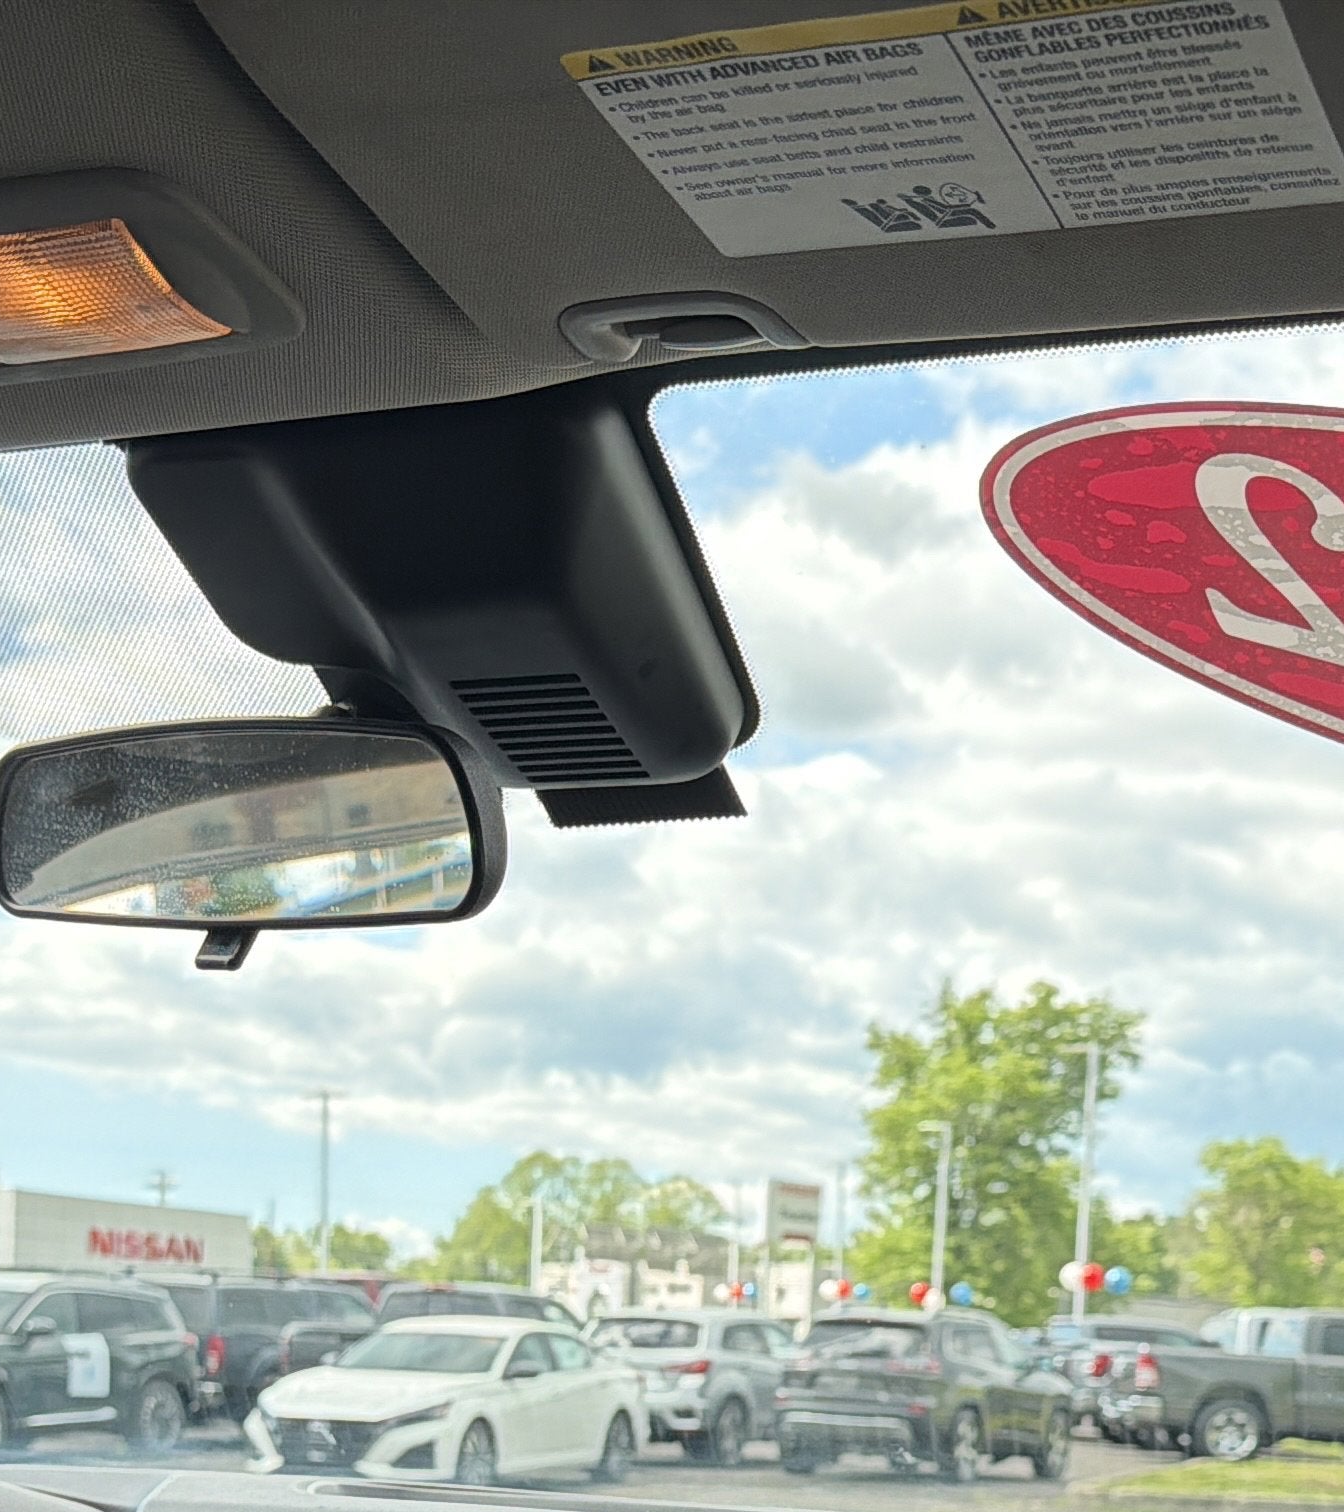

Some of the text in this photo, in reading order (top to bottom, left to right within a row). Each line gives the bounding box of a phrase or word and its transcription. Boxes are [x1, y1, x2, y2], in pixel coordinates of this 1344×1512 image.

[1031, 20, 1082, 39] AVEC
[1085, 14, 1127, 32] DES
[1131, 2, 1234, 26] COUSSINS
[616, 37, 737, 66] WARNING
[974, 35, 1100, 62] GONFLABLES
[1020, 60, 1078, 74] enfants
[1080, 51, 1143, 68] peuvent
[594, 42, 922, 96] EVEN WITH ADVANCED AIR BAGS
[618, 65, 918, 112] Children can be killed or seriously injured
[1130, 90, 1164, 104] pour
[1196, 81, 1254, 95] enfants
[640, 130, 670, 140] The
[670, 125, 706, 136] back
[709, 120, 741, 131] seat
[758, 115, 784, 125] the
[786, 109, 832, 122] safest
[833, 105, 875, 118] place
[876, 102, 897, 112] for
[902, 95, 963, 109] children
[646, 110, 672, 120] the
[694, 103, 726, 114] bag
[1208, 111, 1231, 121] sur
[656, 145, 697, 158] Never
[700, 141, 725, 153] put
[740, 131, 819, 146] rear-facing
[820, 126, 857, 138] child
[859, 122, 893, 134] seat
[911, 118, 937, 128] the
[939, 112, 976, 124] front
[672, 134, 963, 175] Always use seat belts and child restraints
[1042, 152, 1104, 165] Toujours
[683, 153, 975, 191] See owner's manual for more information
[694, 183, 792, 201] about air bags
[1061, 189, 1095, 200] Pour
[1121, 183, 1152, 195] plus
[1092, 206, 1145, 219] manuel
[1170, 196, 1250, 211] conducteur
[88, 1224, 205, 1264] NISSAN
